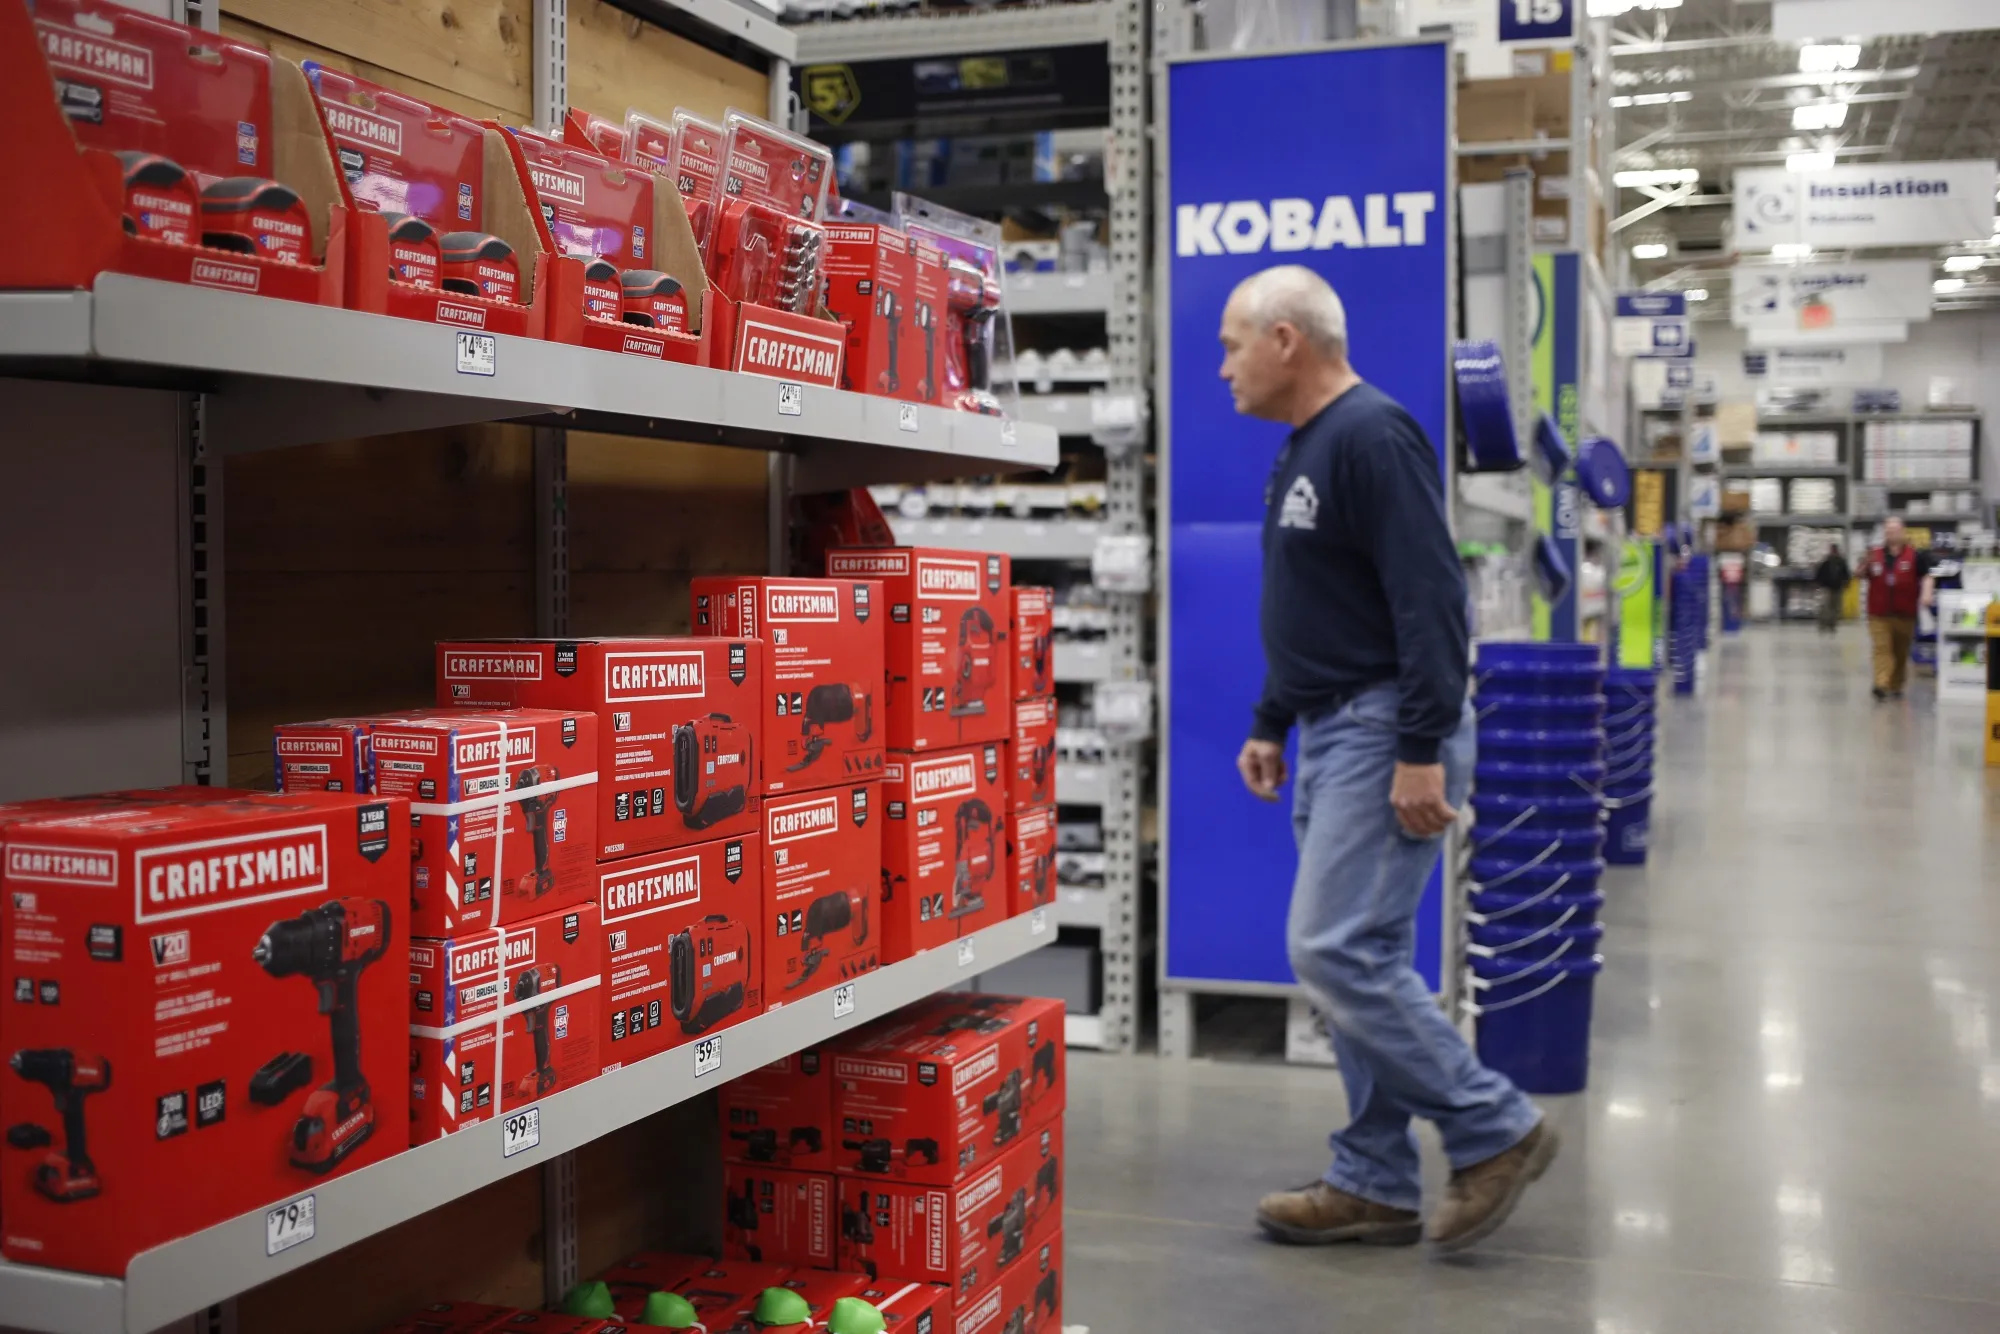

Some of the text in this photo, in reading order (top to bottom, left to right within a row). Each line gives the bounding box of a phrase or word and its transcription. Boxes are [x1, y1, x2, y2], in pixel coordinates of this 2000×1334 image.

[38, 30, 145, 77] RAFTSMAN
[323, 107, 396, 145] RAFTSMAN
[636, 156, 668, 174] CRAFTSMA
[681, 154, 719, 175] CRAFTSMAN
[731, 157, 766, 179] CRAFTSMAN
[532, 170, 580, 196] AFTSMAN
[680, 175, 689, 191] 24
[728, 176, 738, 192] 24
[1811, 178, 1949, 198] Insulation
[133, 193, 191, 215] CRAFTSMAN
[458, 194, 472, 206] USA
[252, 216, 304, 236] CRAFTSMAN
[1176, 191, 1435, 257] KOBALT
[632, 235, 645, 246] USA
[825, 230, 870, 240] RAFTSMAN
[395, 249, 437, 266] CRAFTSMAN
[196, 264, 255, 284] CRAFTSMAN
[479, 266, 514, 282] CRAFTSMAN
[584, 286, 618, 300] CRAFTSMAN
[440, 306, 483, 324] CRAFTSMAN
[653, 301, 683, 314] CRAFTSMAN
[626, 340, 661, 354] CRAFTSMAN
[748, 336, 835, 377] CRAFTSMAN
[834, 558, 904, 570] CRAFTSMAN
[921, 568, 976, 589] CRAFTSMAN
[772, 595, 834, 613] CRAFTSMAN
[743, 591, 753, 638] CRAFTS
[451, 659, 535, 673] CRAFTSMAN
[612, 663, 699, 689] CRAFTSMAN
[613, 713, 629, 730] V20
[281, 742, 338, 751] CRAFTSMAN
[375, 737, 432, 750] CRAFTSMAN
[393, 762, 423, 770] BRUSHLESS
[717, 754, 740, 765] CRAFTSMAN
[479, 777, 509, 793] BRUSHLS
[916, 765, 971, 792] CRAFTSMAN
[361, 810, 385, 822] 3 YEAR
[554, 819, 567, 830] USA
[774, 806, 833, 834] CRAFTSMAN
[361, 820, 385, 832] LIMITED
[12, 853, 109, 876] CRAFTSMAN
[150, 843, 316, 903] CRAFTSMAN
[607, 869, 694, 910] CRAFTSMAN
[350, 924, 375, 937] CRAFTSMAN
[152, 933, 187, 965] V20
[609, 932, 624, 951] V20
[713, 951, 736, 966] CRAFTSMAN
[460, 981, 508, 1004] V20 BRUSHLS
[554, 1015, 568, 1027] USA
[840, 1063, 903, 1078] CRAFTSMAN
[956, 1053, 996, 1085] CRAFTSMAN
[199, 1092, 222, 1112] LED
[332, 1112, 365, 1140] CRAFTSMAN
[813, 1184, 823, 1250] CRAFTSMAN
[931, 1197, 943, 1265] CRAFTSMAN
